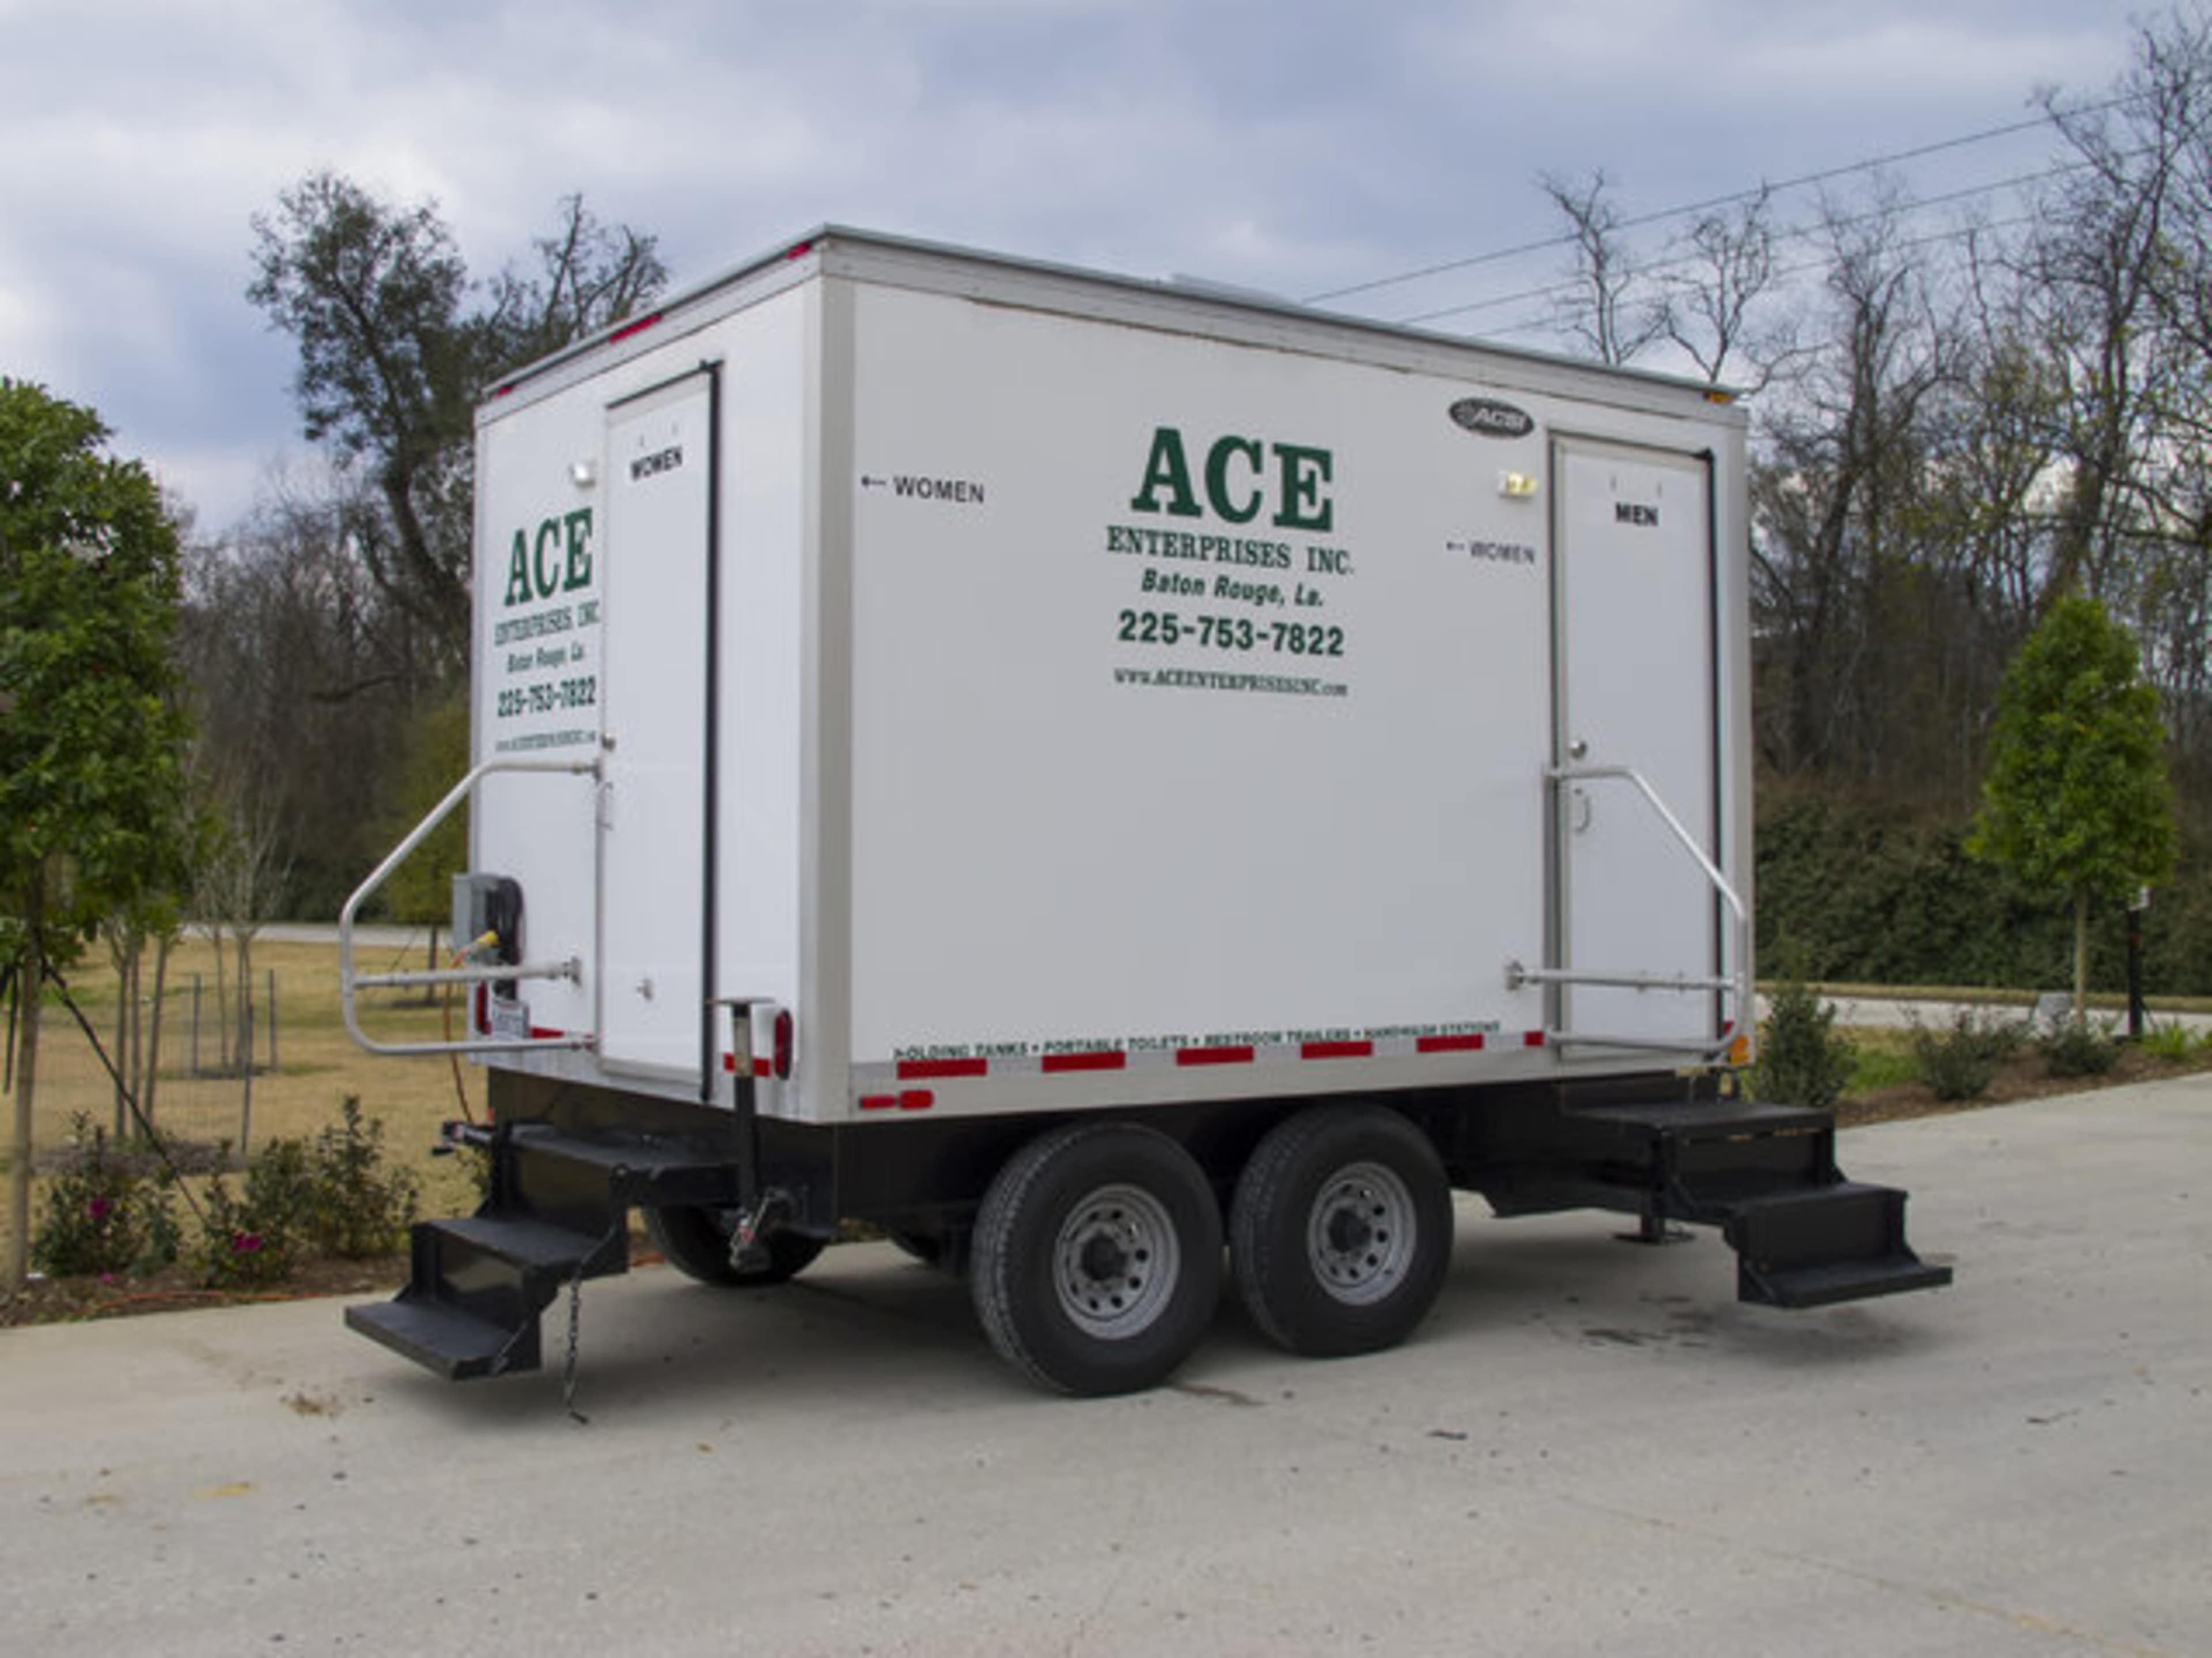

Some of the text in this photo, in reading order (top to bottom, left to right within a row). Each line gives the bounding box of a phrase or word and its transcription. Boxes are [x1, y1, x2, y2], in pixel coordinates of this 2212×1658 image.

[630, 445, 683, 481] WOMEN
[1131, 426, 1332, 532] ACE
[893, 476, 984, 503] WOMEN
[1615, 502, 1658, 526] MEN
[504, 507, 592, 607] ACE
[1107, 525, 1354, 575] ENTERPRISES INC.
[1470, 540, 1535, 564] WOMEN
[1141, 567, 1323, 607] Baton Rouge, La.
[494, 606, 572, 647] ENTERPRISES
[1118, 609, 1345, 657] 225-753-7822
[498, 675, 596, 717] 225-753-7822
[976, 1040, 1028, 1057] TANKS
[1044, 1038, 1123, 1053] PORTABLE
[1128, 1035, 1188, 1050] TOILETS
